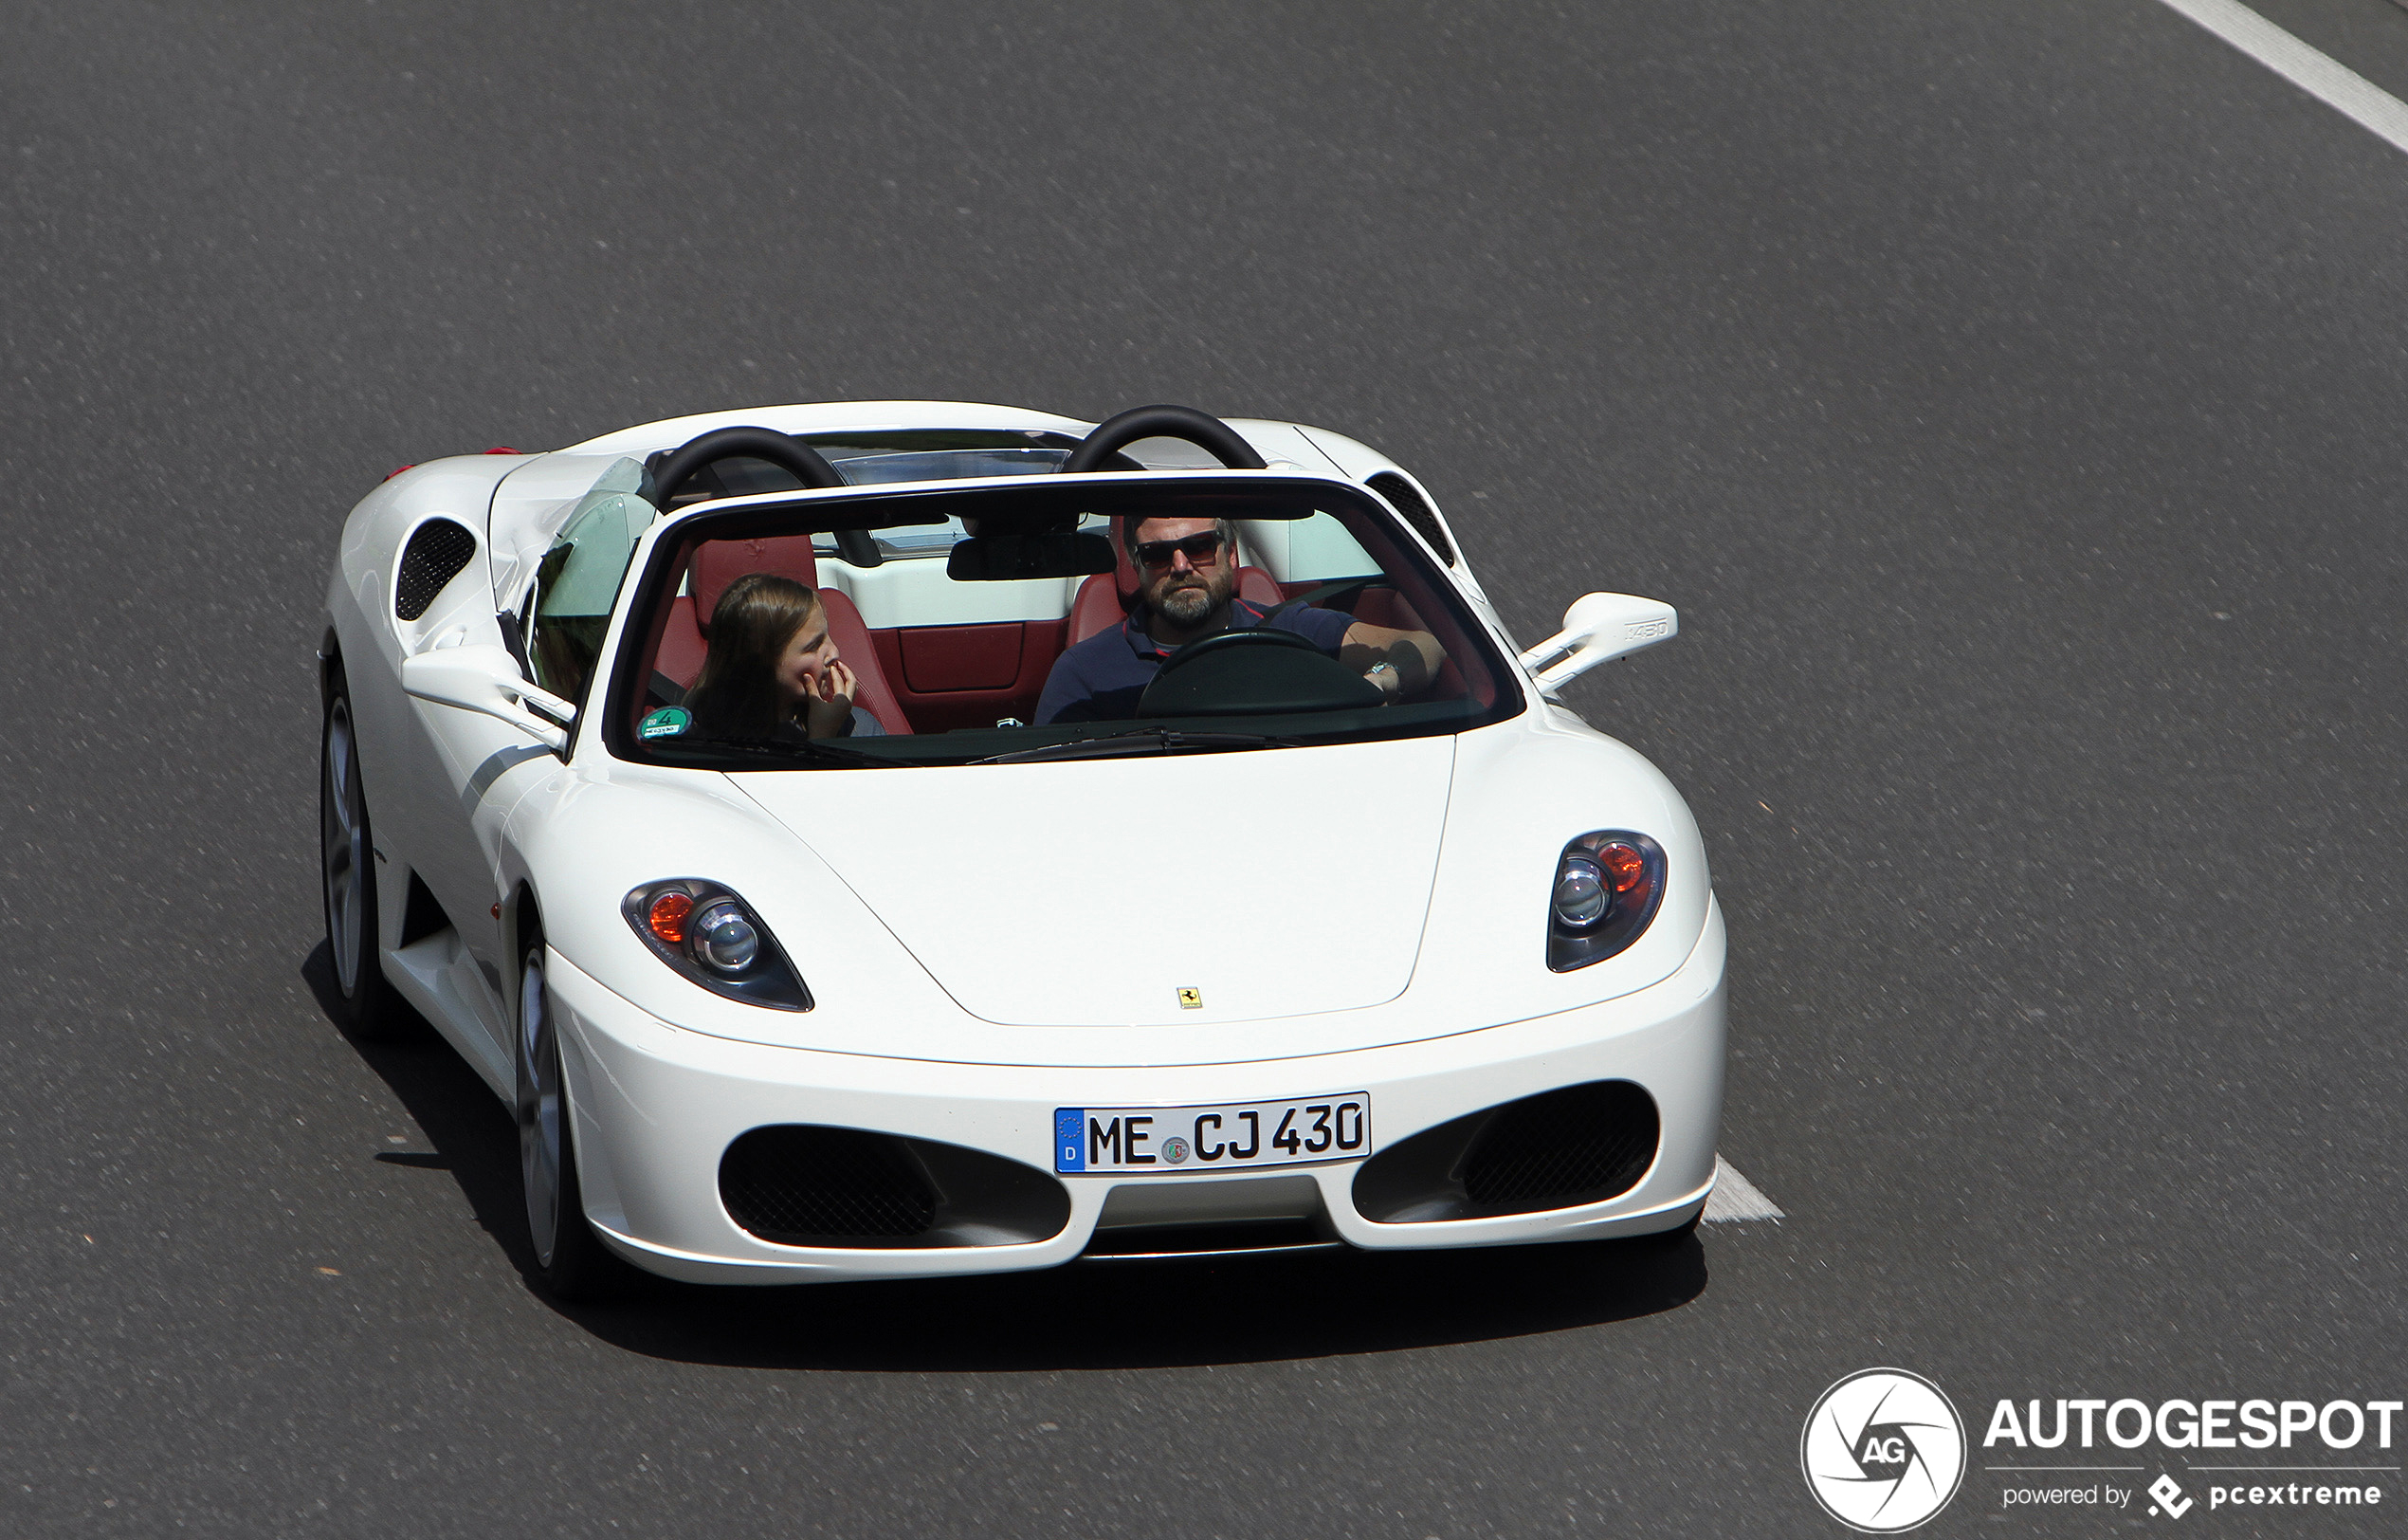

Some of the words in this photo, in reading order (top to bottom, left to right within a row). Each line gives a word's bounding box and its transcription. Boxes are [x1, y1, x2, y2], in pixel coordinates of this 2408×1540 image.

[658, 710, 672, 724] 4
[1089, 1116, 1157, 1164] ME
[1194, 1110, 1260, 1162] CJ
[1272, 1102, 1363, 1155] 430
[1065, 1146, 1076, 1161] D
